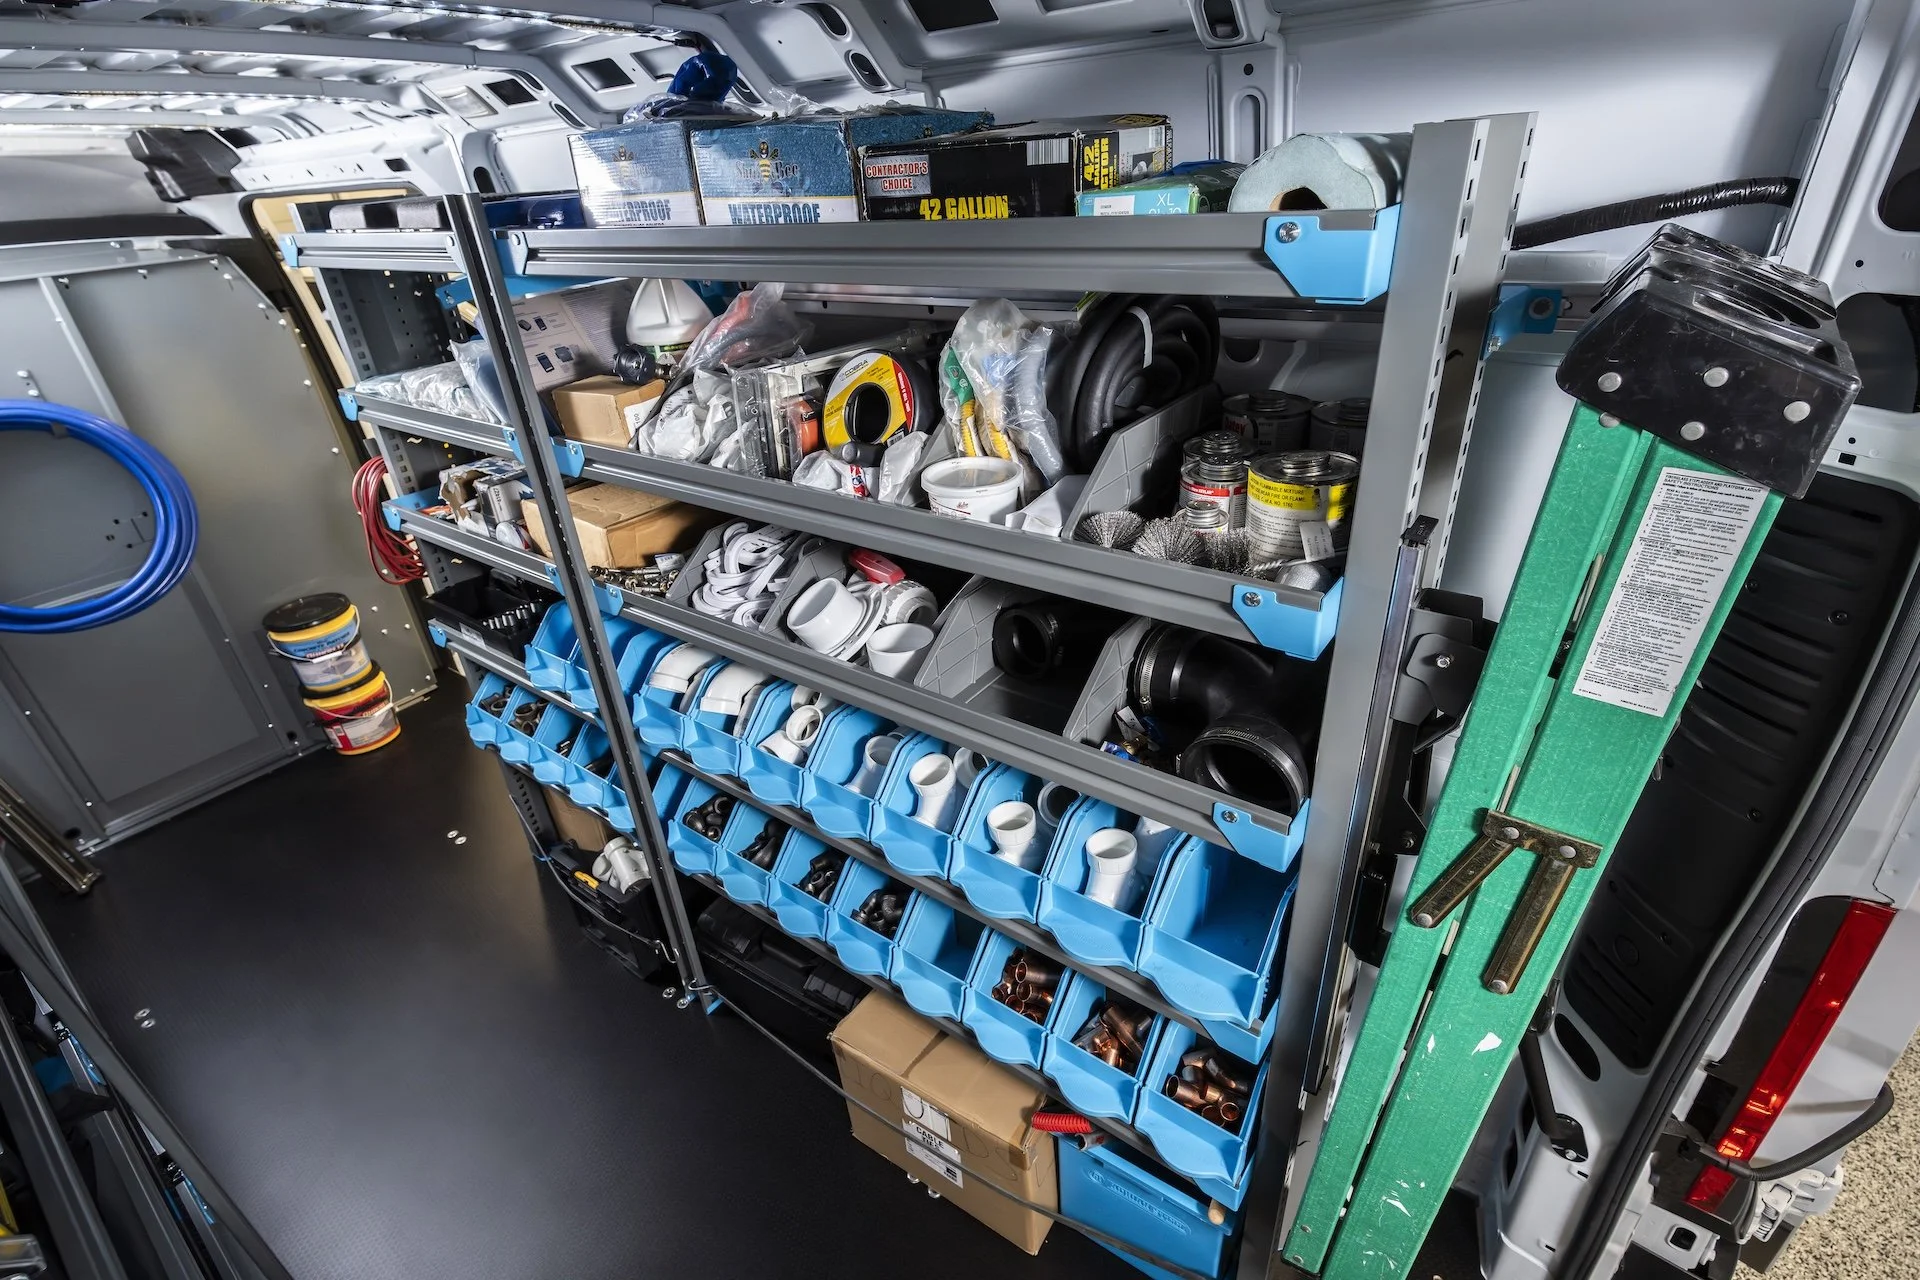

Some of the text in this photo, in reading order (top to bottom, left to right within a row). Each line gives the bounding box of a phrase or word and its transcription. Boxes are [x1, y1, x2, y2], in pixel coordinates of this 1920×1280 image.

[866, 161, 928, 178] CONTRACTOR'S
[1084, 146, 1094, 182] 42
[882, 178, 913, 191] CHOICE
[920, 198, 942, 220] 42
[945, 195, 1008, 220] GALLON
[1157, 193, 1175, 206] XL
[728, 204, 820, 224] WATERPROOF
[916, 1126, 944, 1150] CABLE
